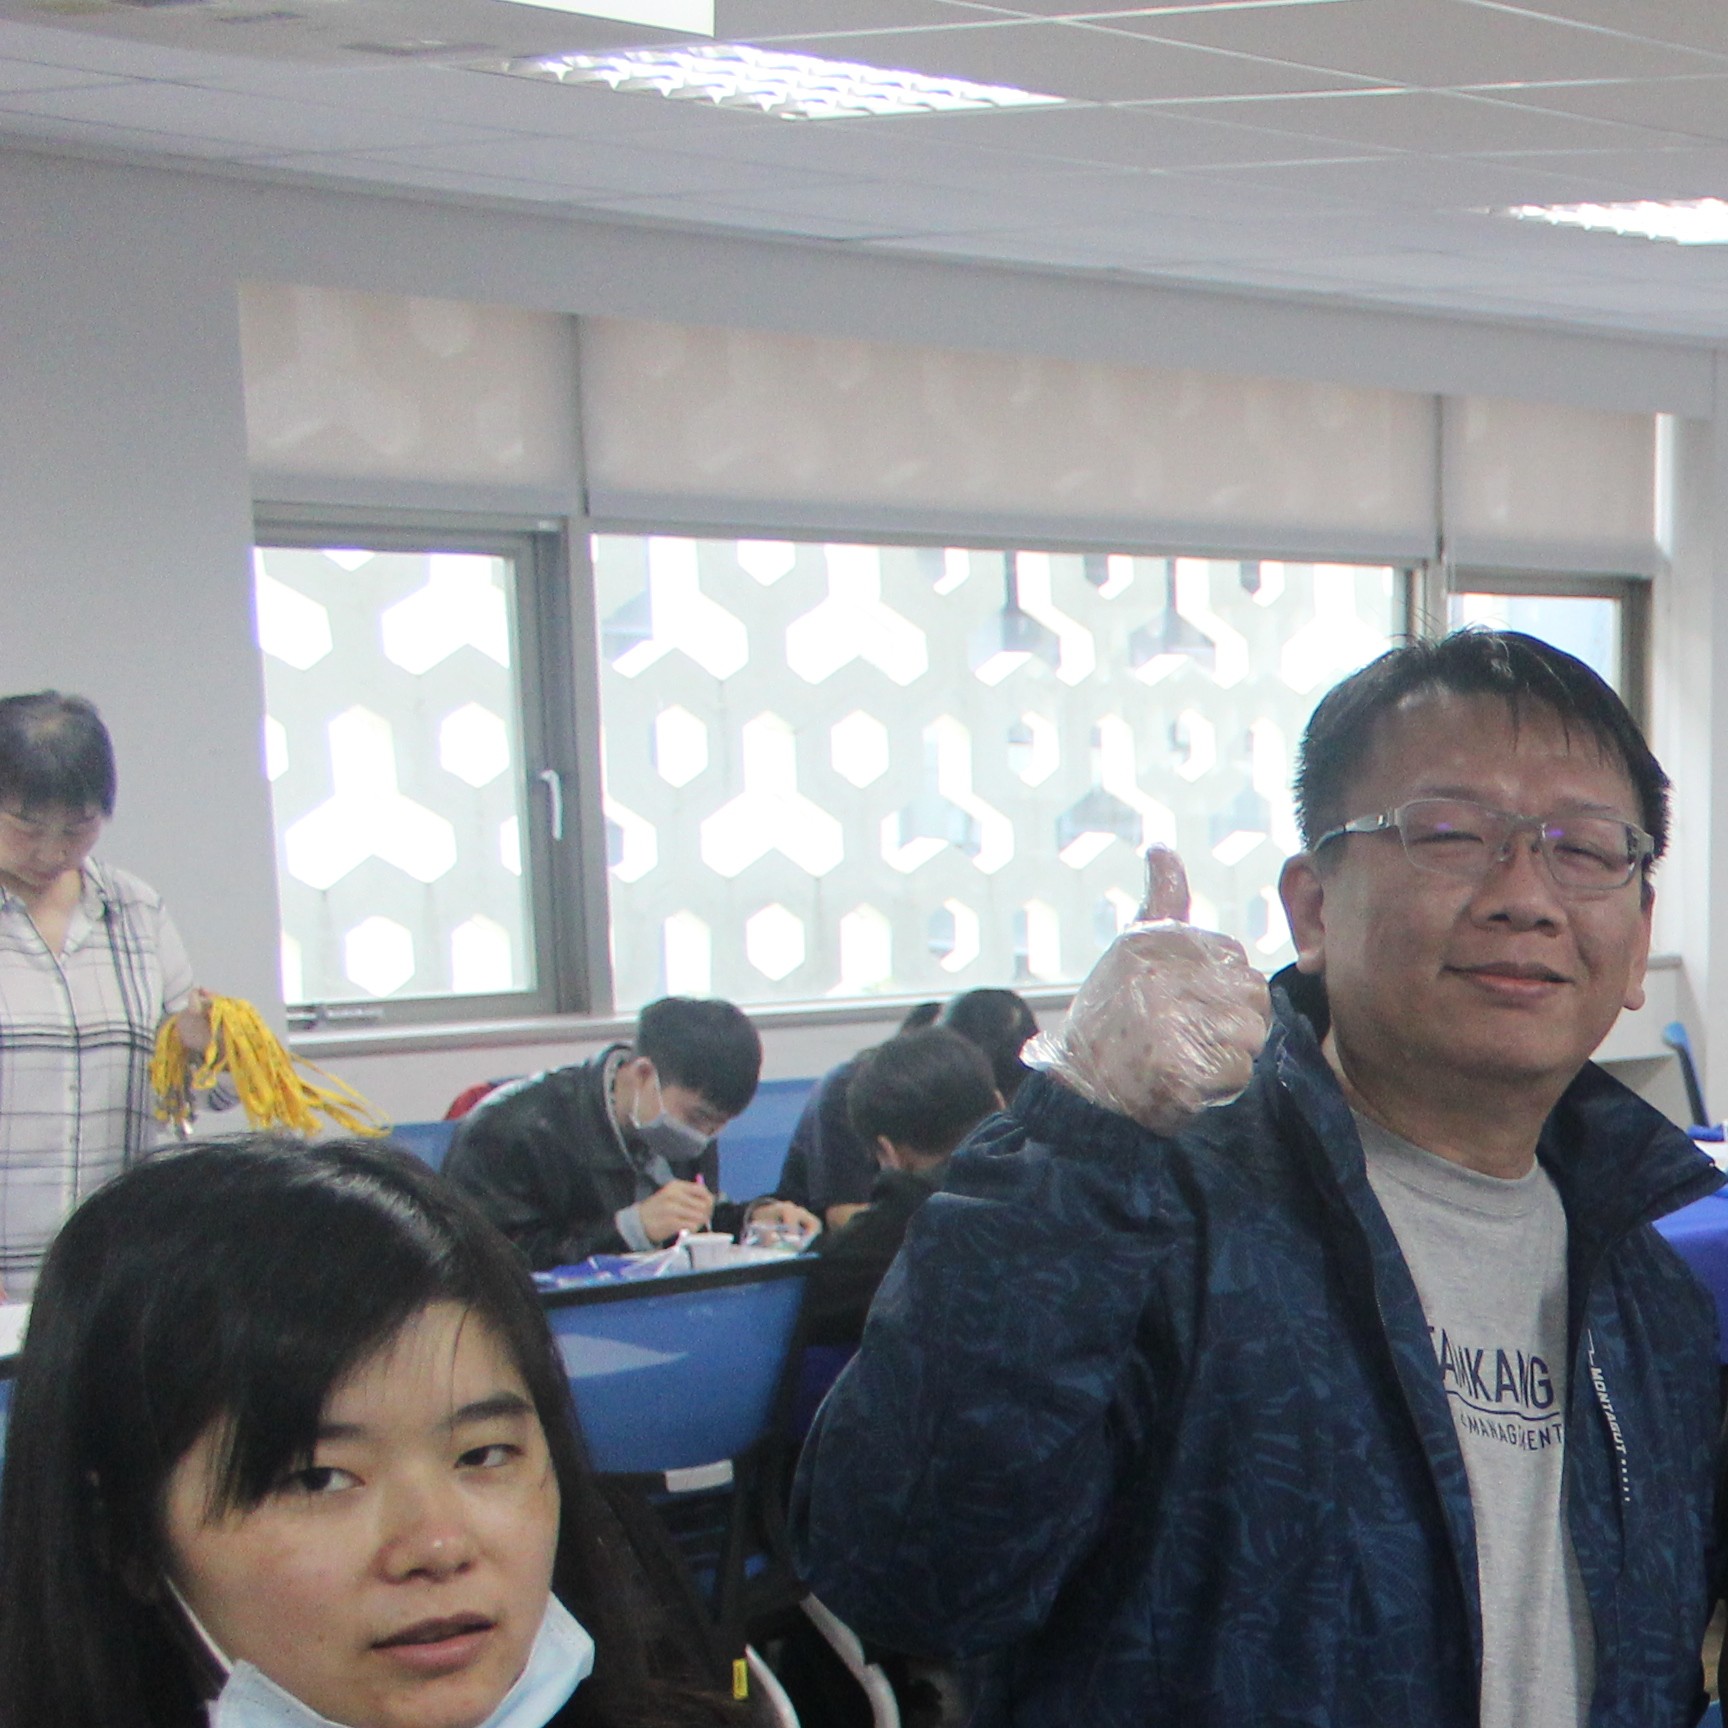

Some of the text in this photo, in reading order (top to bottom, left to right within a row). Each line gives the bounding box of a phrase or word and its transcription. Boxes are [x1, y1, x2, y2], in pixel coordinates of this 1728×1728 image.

[1427, 1325, 1554, 1409] AMKANG
[1467, 1415, 1563, 1451] MANAGENT
[1590, 1366, 1627, 1454] MONTAGUT
